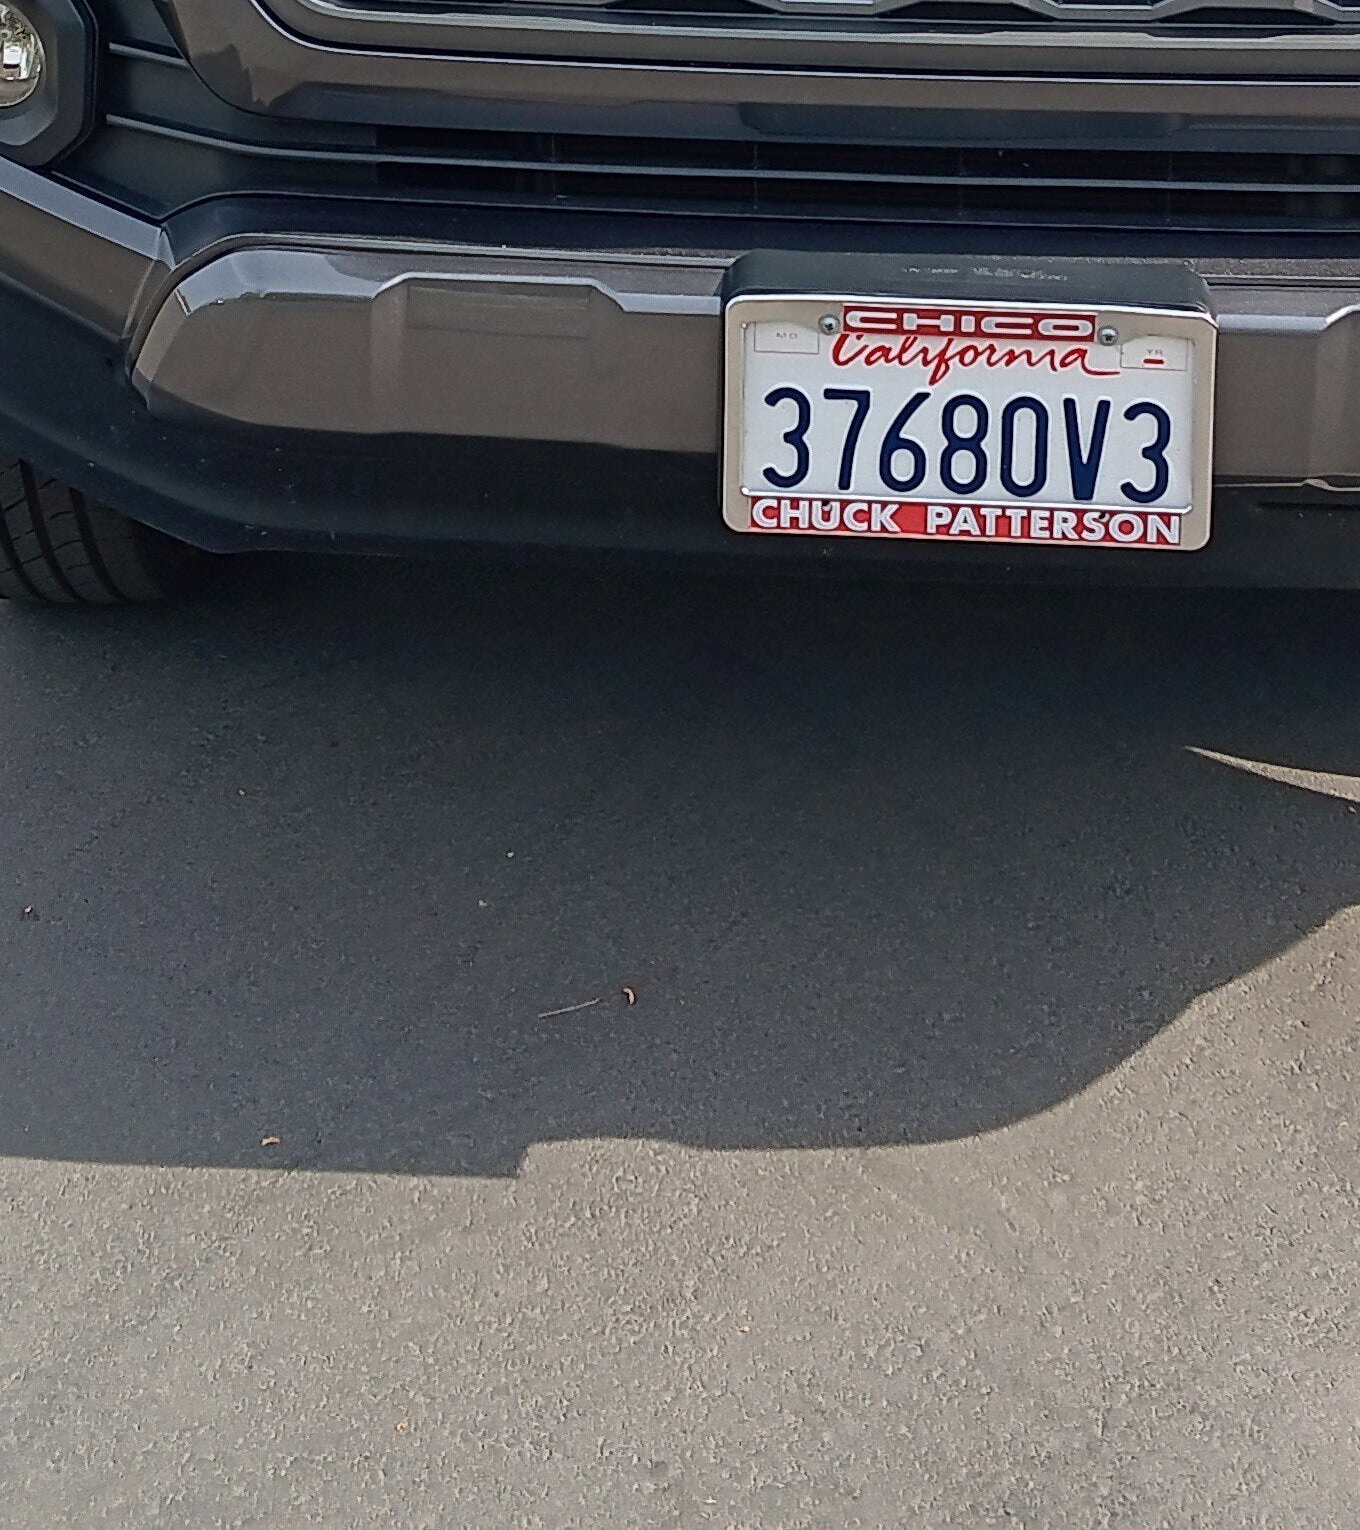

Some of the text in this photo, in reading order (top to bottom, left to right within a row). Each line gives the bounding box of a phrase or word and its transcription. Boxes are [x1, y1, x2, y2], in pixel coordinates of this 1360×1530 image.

[846, 310, 1093, 337] CHICO
[832, 333, 1121, 387] California
[762, 387, 1172, 504] 37680V3
[752, 498, 1180, 544] CHUCK PATTERSON
